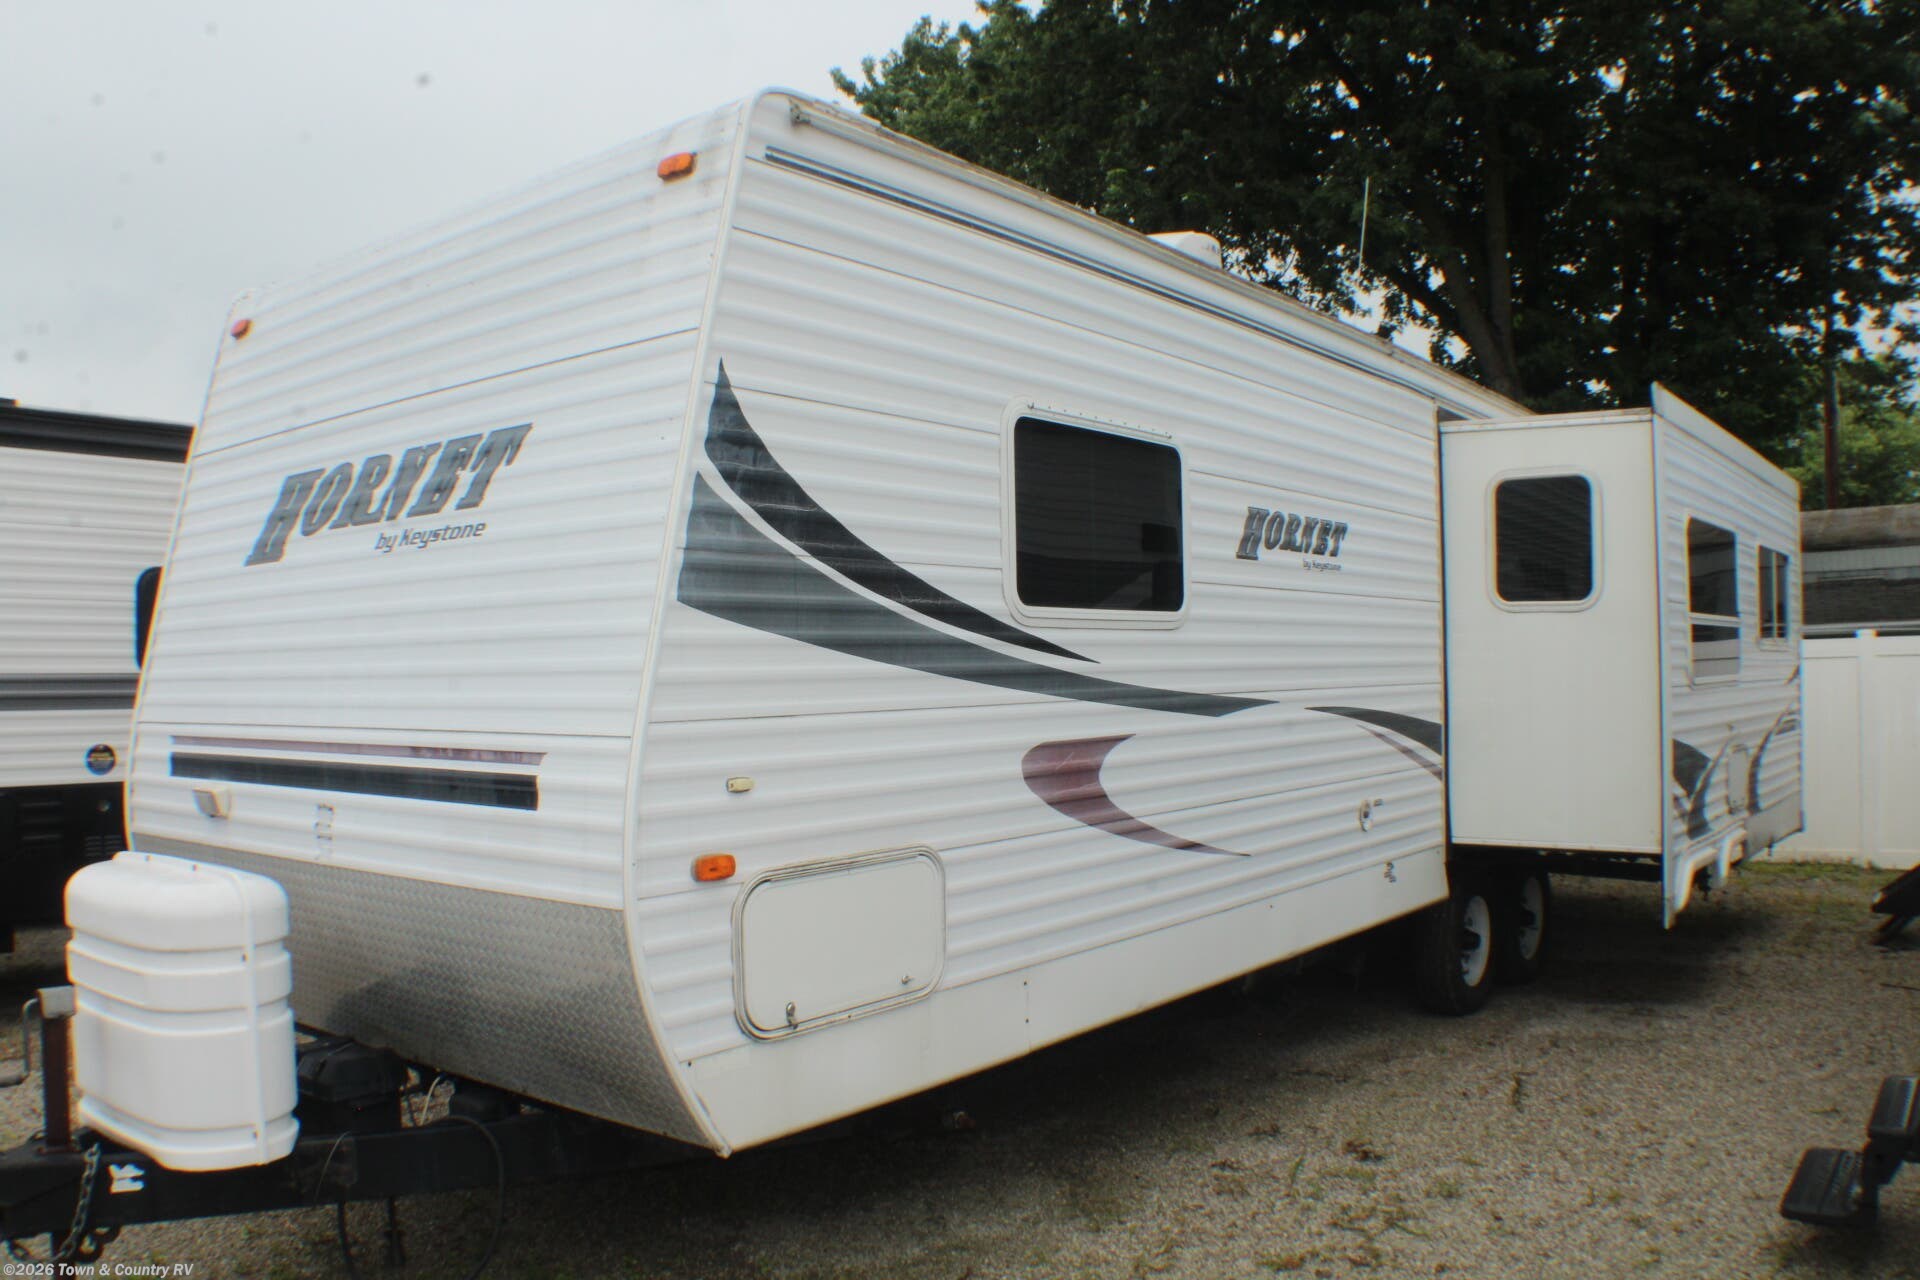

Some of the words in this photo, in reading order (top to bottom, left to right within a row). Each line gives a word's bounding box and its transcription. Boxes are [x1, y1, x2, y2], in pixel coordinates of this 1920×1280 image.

[243, 422, 534, 566] HORNET
[374, 532, 398, 553] by
[399, 522, 486, 549] Keystone
[1236, 506, 1348, 560] HORNET
